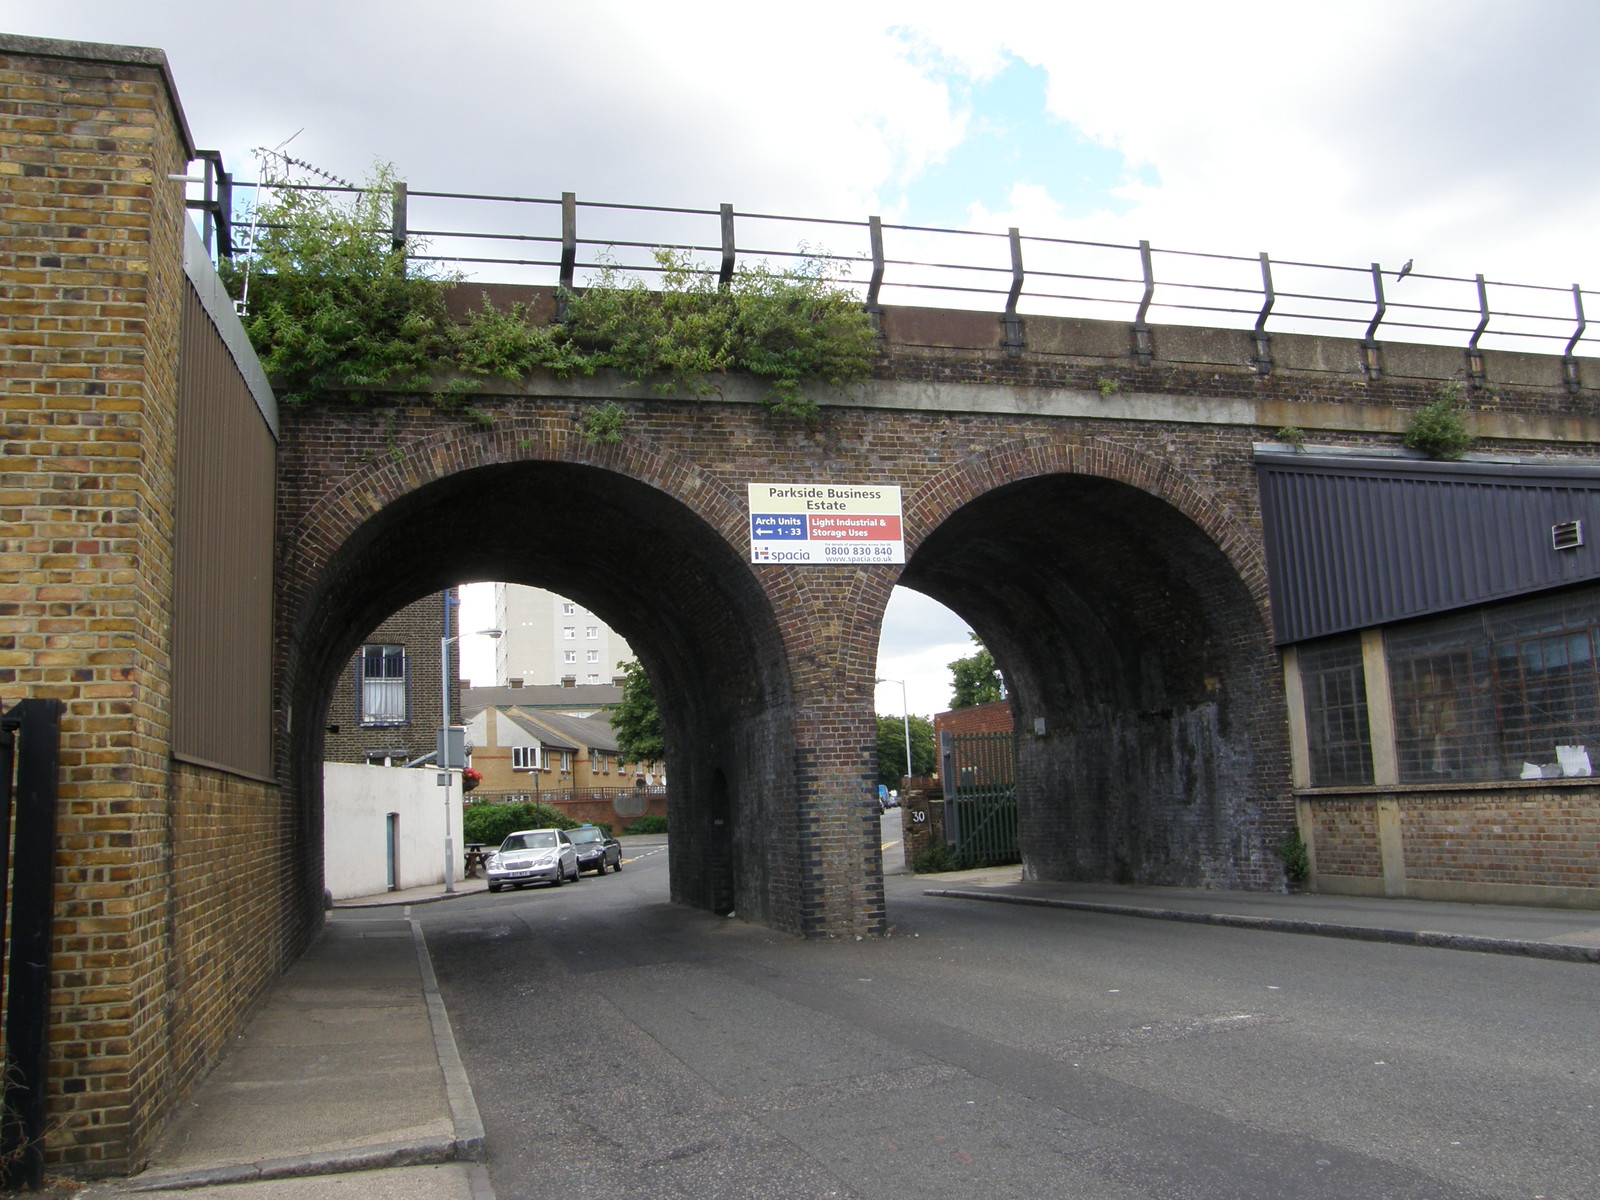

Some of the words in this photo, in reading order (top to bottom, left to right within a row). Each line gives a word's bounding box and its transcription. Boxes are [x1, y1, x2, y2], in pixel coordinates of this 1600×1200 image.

[769, 488, 824, 498] Parkside
[827, 488, 881, 499] Business
[806, 500, 847, 510] Estate
[755, 517, 776, 525] Arch
[778, 517, 801, 526] Units
[812, 518, 834, 528] Light
[836, 518, 878, 527] Industrial
[879, 519, 887, 527] &
[777, 528, 782, 536] 1
[790, 528, 802, 536] 33
[812, 529, 846, 538] Storage
[848, 529, 868, 537] Uses
[771, 549, 810, 562] spacia
[824, 547, 850, 556] 0800
[852, 547, 871, 556] 830
[874, 547, 893, 556] 840
[912, 811, 925, 822] 30
